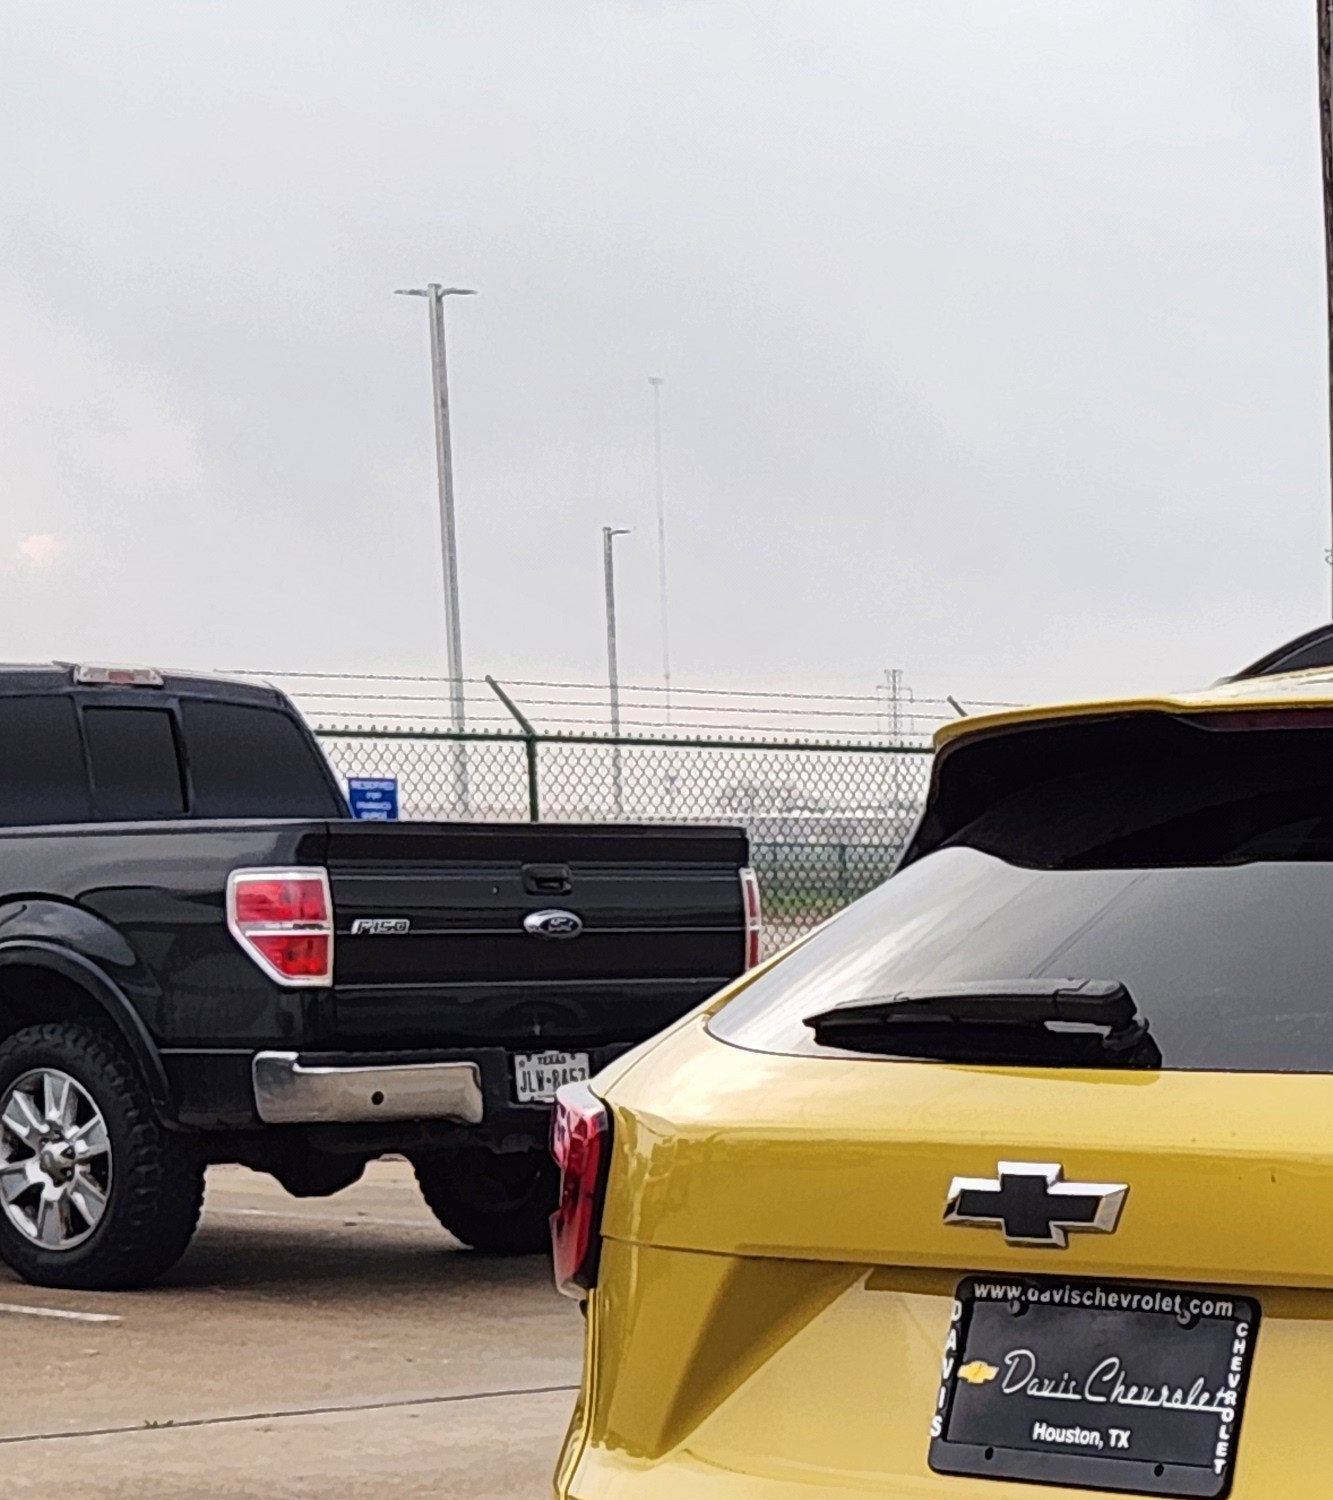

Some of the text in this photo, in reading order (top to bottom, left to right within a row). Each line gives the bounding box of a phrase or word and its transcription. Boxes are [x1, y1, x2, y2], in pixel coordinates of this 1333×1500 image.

[537, 1054, 567, 1065] TEXAS
[974, 1282, 1234, 1318] www.davischevroletcom
[930, 1299, 962, 1437] DAVIS
[1002, 1349, 1232, 1414] Davis Chevrolet
[1213, 1322, 1249, 1475] CHEVROLET
[1032, 1420, 1132, 1450] Houston, TX
